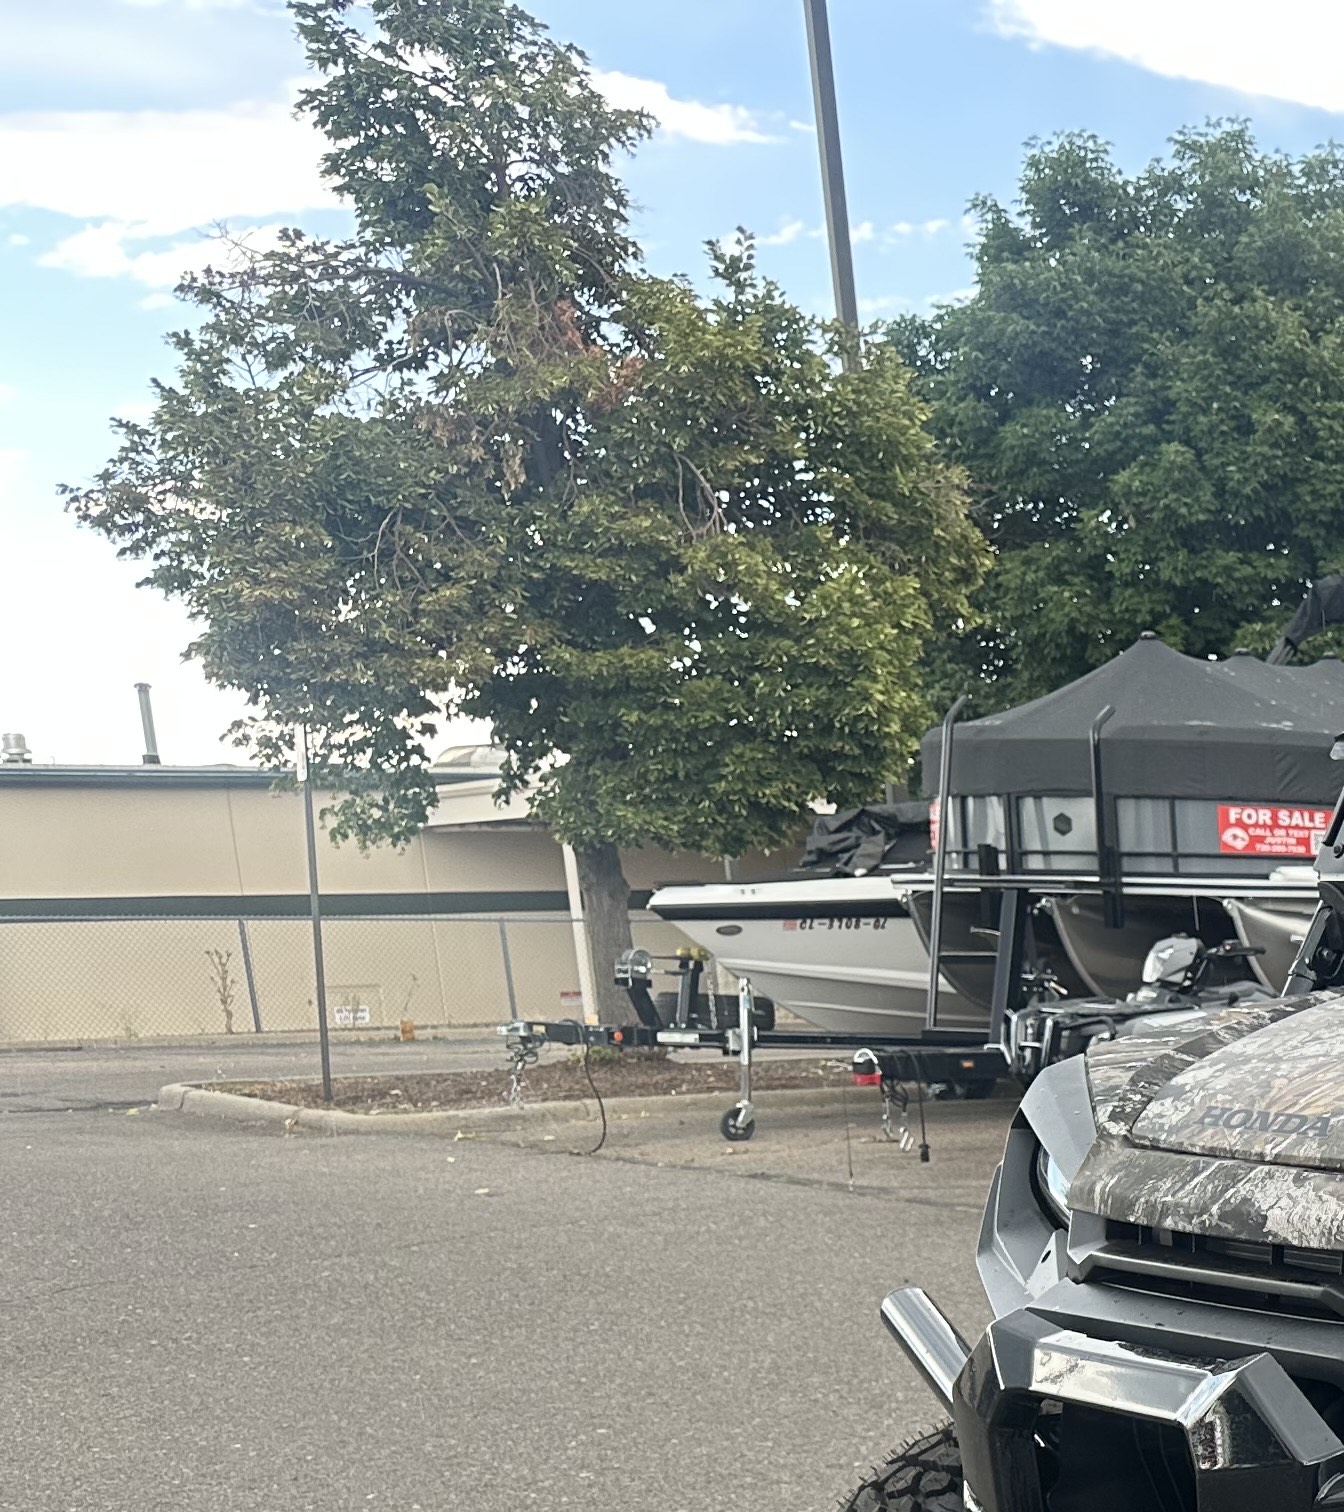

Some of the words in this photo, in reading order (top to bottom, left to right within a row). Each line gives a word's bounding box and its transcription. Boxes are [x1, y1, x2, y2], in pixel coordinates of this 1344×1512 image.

[1228, 807, 1273, 825] FOR
[1277, 808, 1326, 828] SALE
[1195, 1105, 1331, 1137] HONDA
